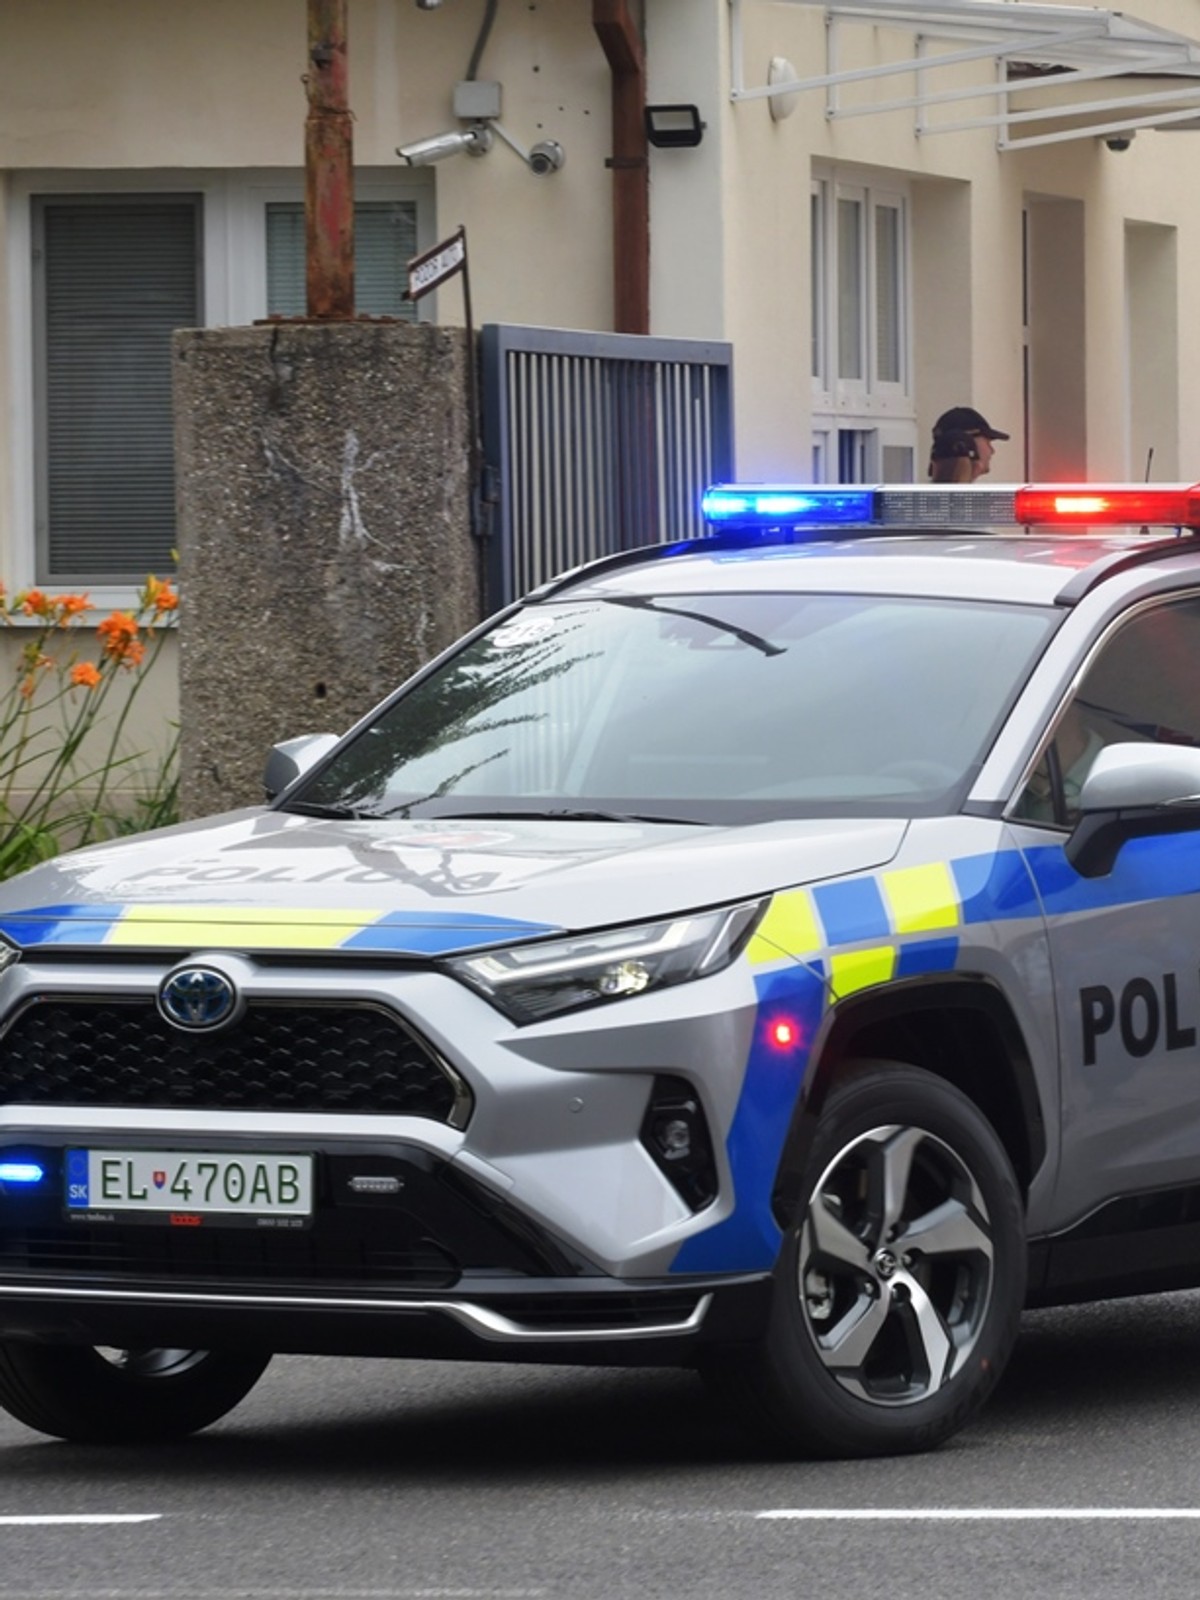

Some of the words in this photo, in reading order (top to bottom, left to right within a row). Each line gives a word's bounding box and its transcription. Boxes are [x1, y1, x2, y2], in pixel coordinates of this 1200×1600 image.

[69, 1184, 88, 1199] SK
[101, 1159, 149, 1201] EL
[170, 1161, 301, 1205] 470AB
